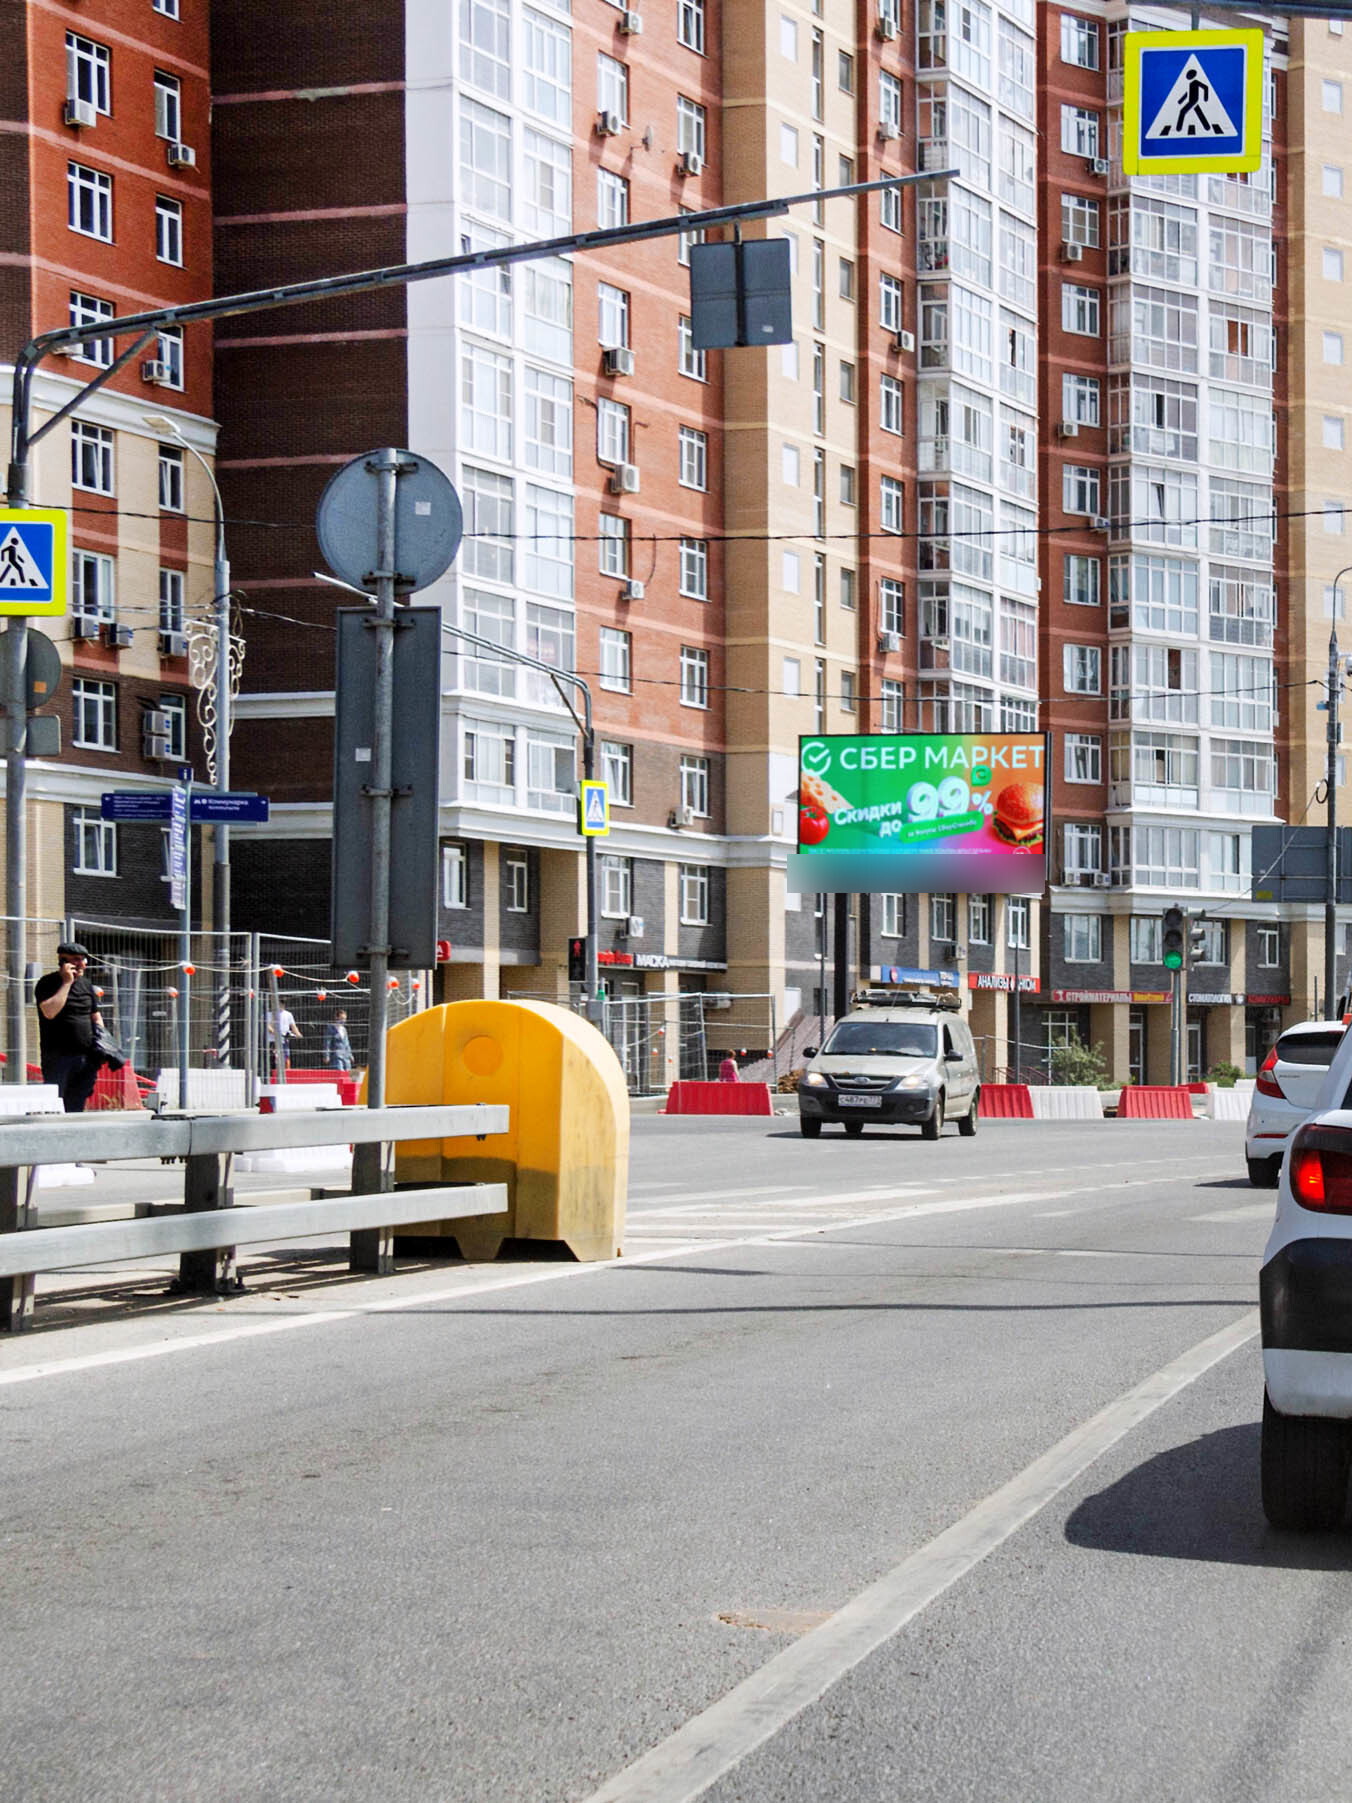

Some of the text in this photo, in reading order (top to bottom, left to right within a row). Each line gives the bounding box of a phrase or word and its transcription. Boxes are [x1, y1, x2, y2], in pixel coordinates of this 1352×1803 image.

[839, 745, 1045, 771] СБЕР МАРКЕТ
[834, 802, 902, 826] Скидки
[879, 819, 903, 838] до
[977, 975, 1009, 990] АНАЛИЗЫ
[1066, 990, 1132, 1003] СТРОЙМАТЕРИАЛЫ
